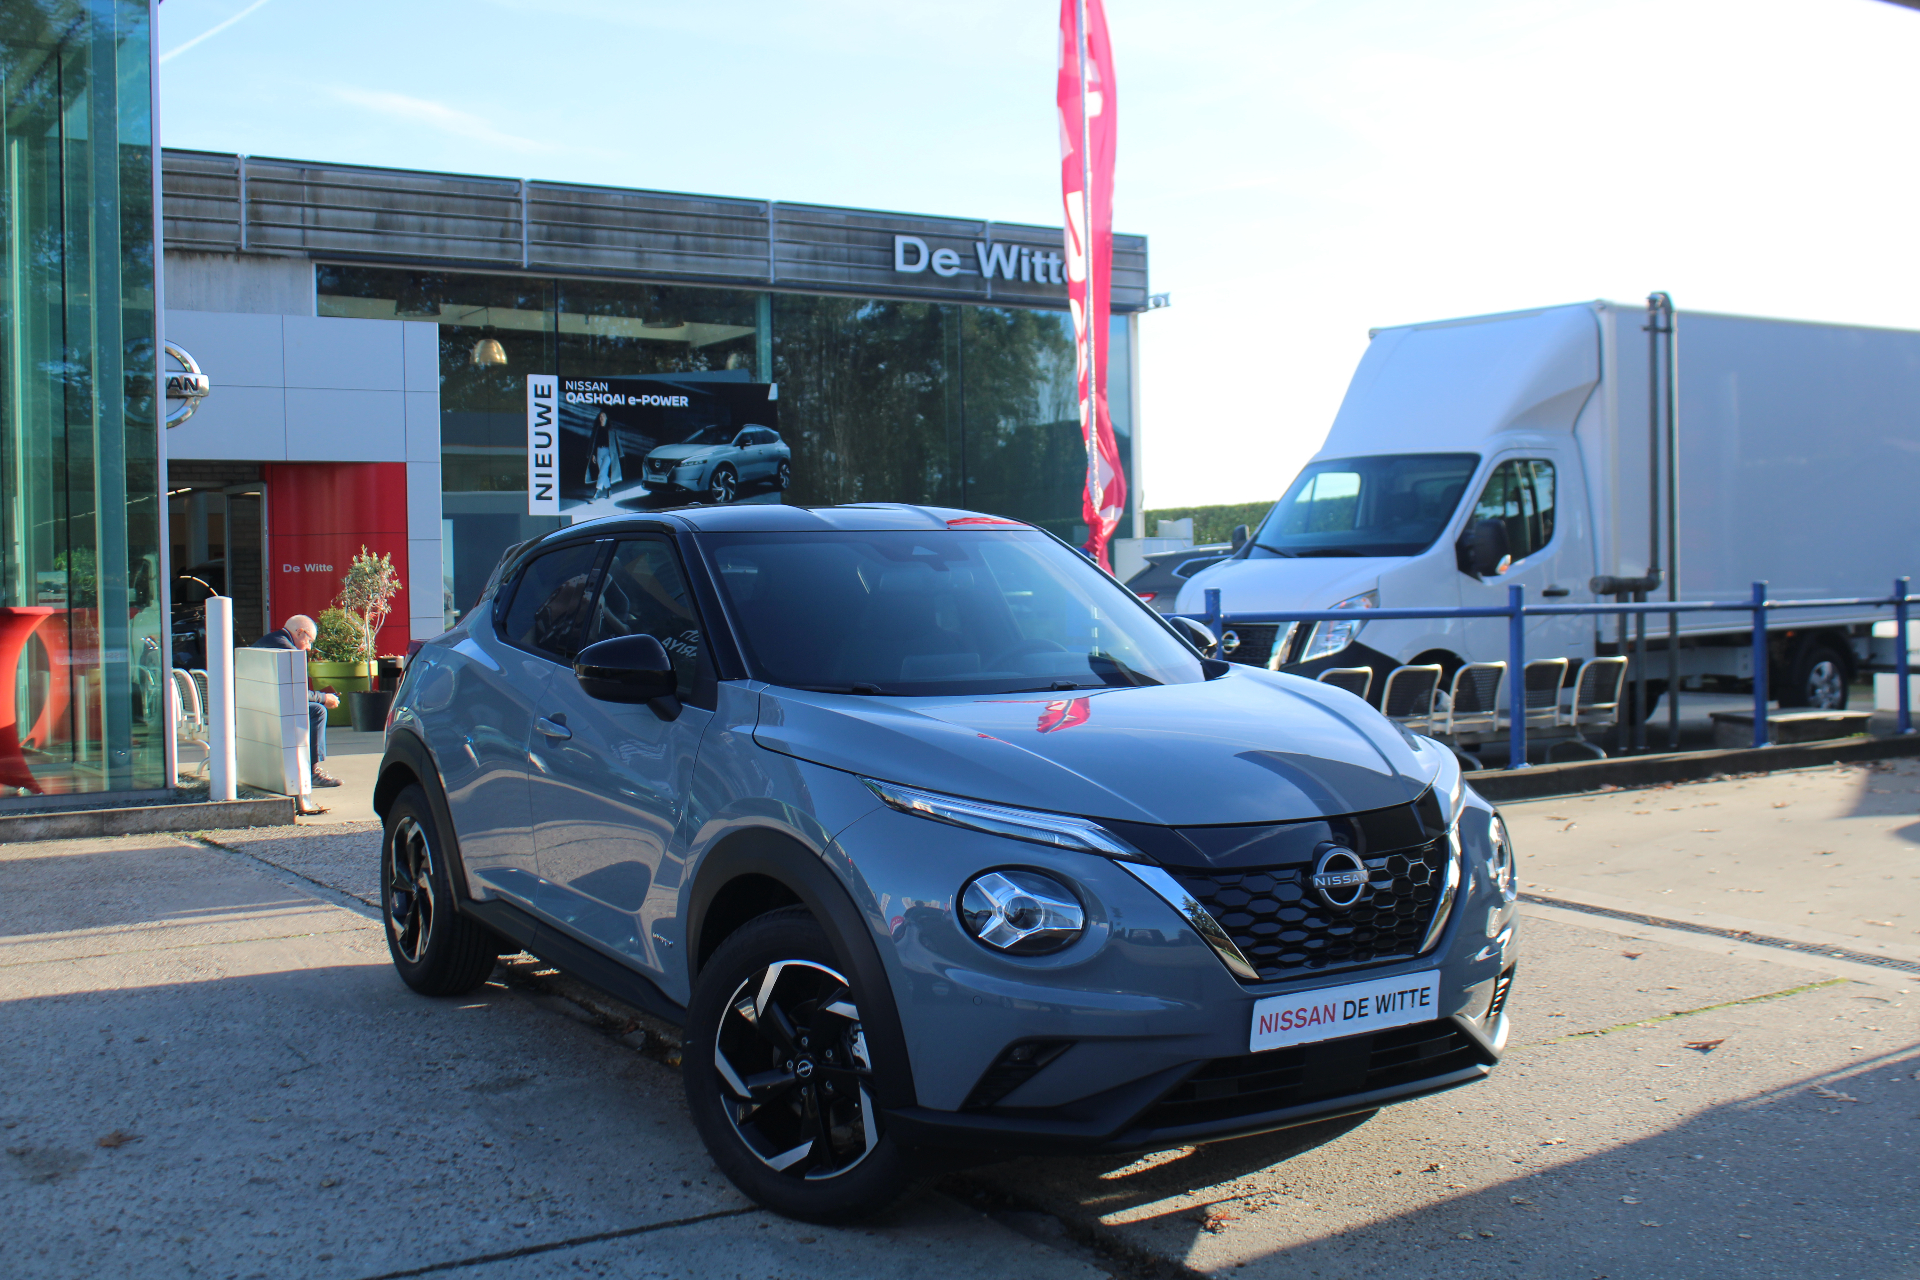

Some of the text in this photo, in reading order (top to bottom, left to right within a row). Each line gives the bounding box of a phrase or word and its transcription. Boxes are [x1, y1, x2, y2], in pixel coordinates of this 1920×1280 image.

[894, 235, 1069, 284] De Witt
[565, 381, 609, 391] NISSAN
[565, 392, 689, 407] QASHQAI e-POWER
[534, 384, 553, 501] NIEUWE
[283, 563, 333, 573] De Witte
[1314, 873, 1367, 886] NISSAN
[1259, 986, 1431, 1035] NISSAN DE WITTE
